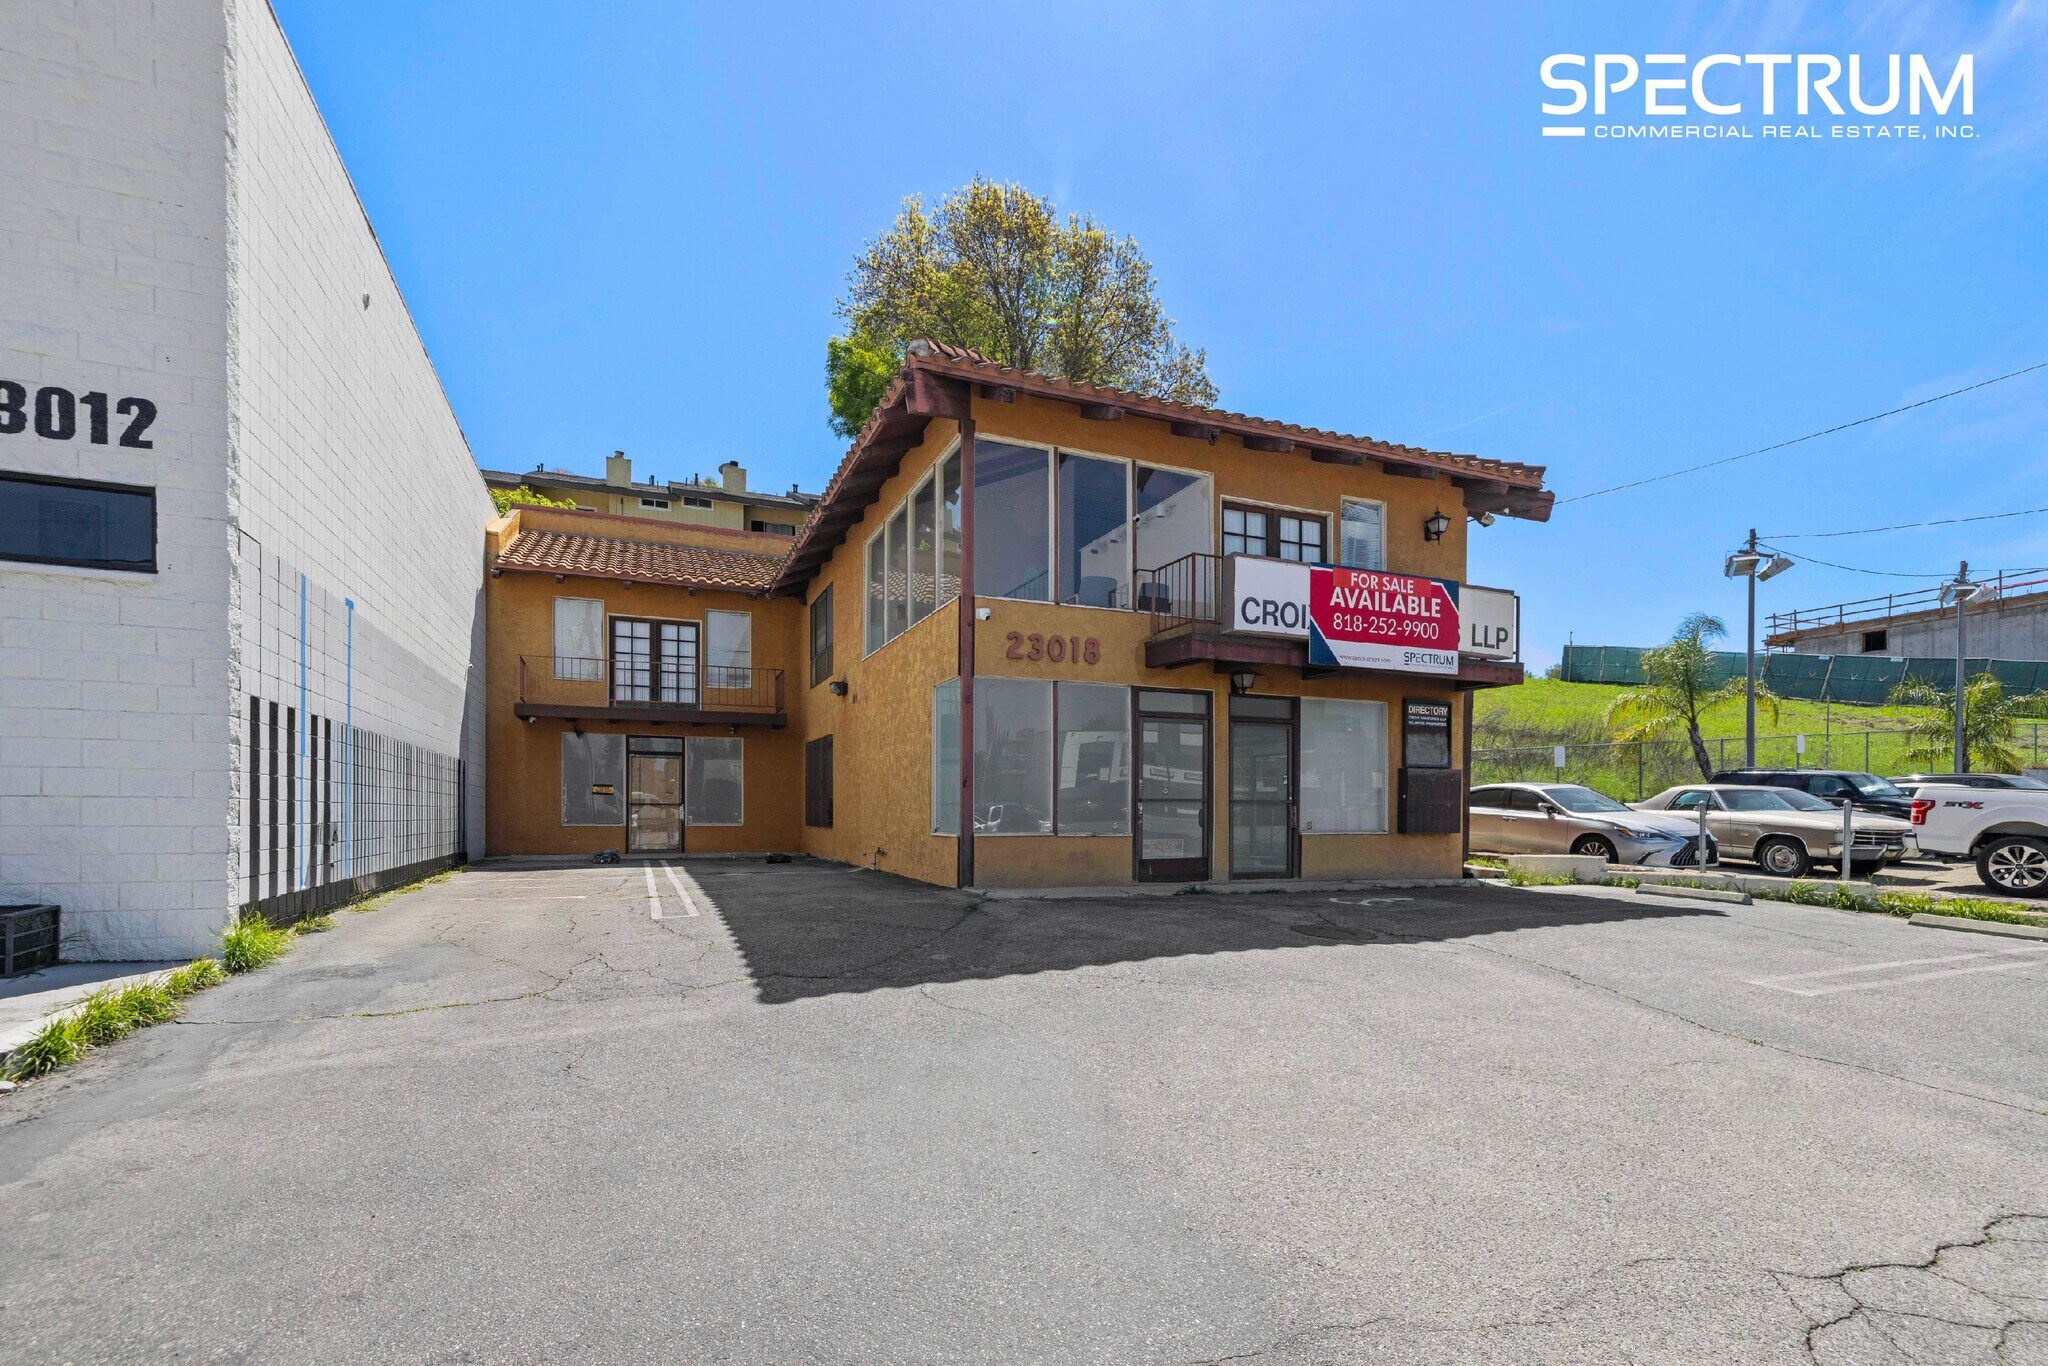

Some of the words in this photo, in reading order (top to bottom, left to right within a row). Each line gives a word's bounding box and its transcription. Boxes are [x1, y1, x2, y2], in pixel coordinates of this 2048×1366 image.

[1351, 572, 1378, 590] FOR
[1382, 578, 1414, 594] SALE
[1241, 597, 1310, 629] CROI
[1330, 586, 1441, 618] AVAILABLE
[1333, 613, 1439, 640] 818-252-9900
[1471, 623, 1509, 650] LLP
[1006, 631, 1101, 665] 23018
[1403, 651, 1454, 666] SPECTRUM
[1408, 705, 1448, 716] DIRECTORY
